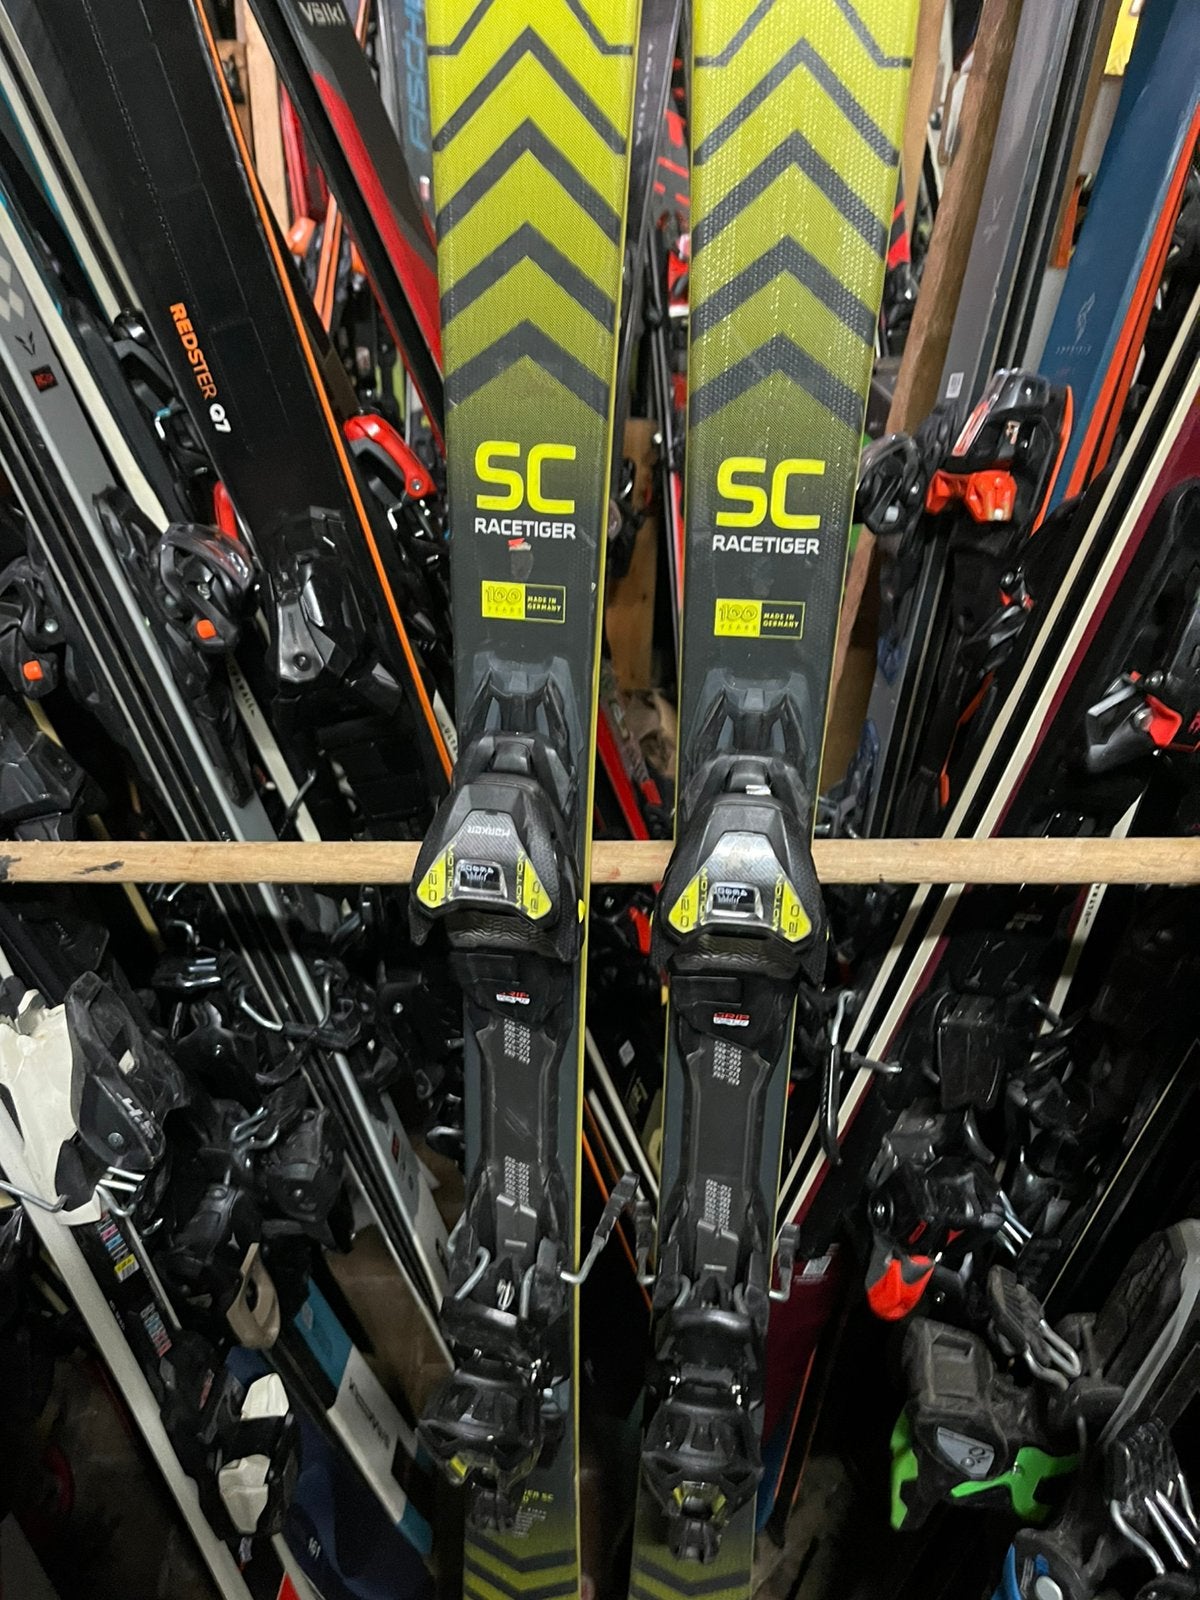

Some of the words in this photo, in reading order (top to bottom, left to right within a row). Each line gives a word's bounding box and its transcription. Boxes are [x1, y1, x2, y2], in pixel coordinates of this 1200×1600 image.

[298, 2, 346, 26] Völkl
[170, 303, 217, 400] REDSTER
[209, 403, 231, 432] Q7
[475, 440, 576, 515] SC
[716, 456, 825, 530] SC
[474, 517, 576, 540] RACETIGER
[712, 534, 820, 555] RACETIGER
[486, 585, 523, 605] 100
[527, 595, 547, 604] MADE
[527, 603, 561, 613] GERMANY
[719, 603, 758, 622] 100
[763, 612, 784, 620] MADE
[763, 620, 799, 629] GERMANY
[446, 840, 458, 901] MOTION
[515, 849, 526, 908] MOTION
[700, 866, 709, 926] MOTION
[772, 873, 784, 932] MOTION
